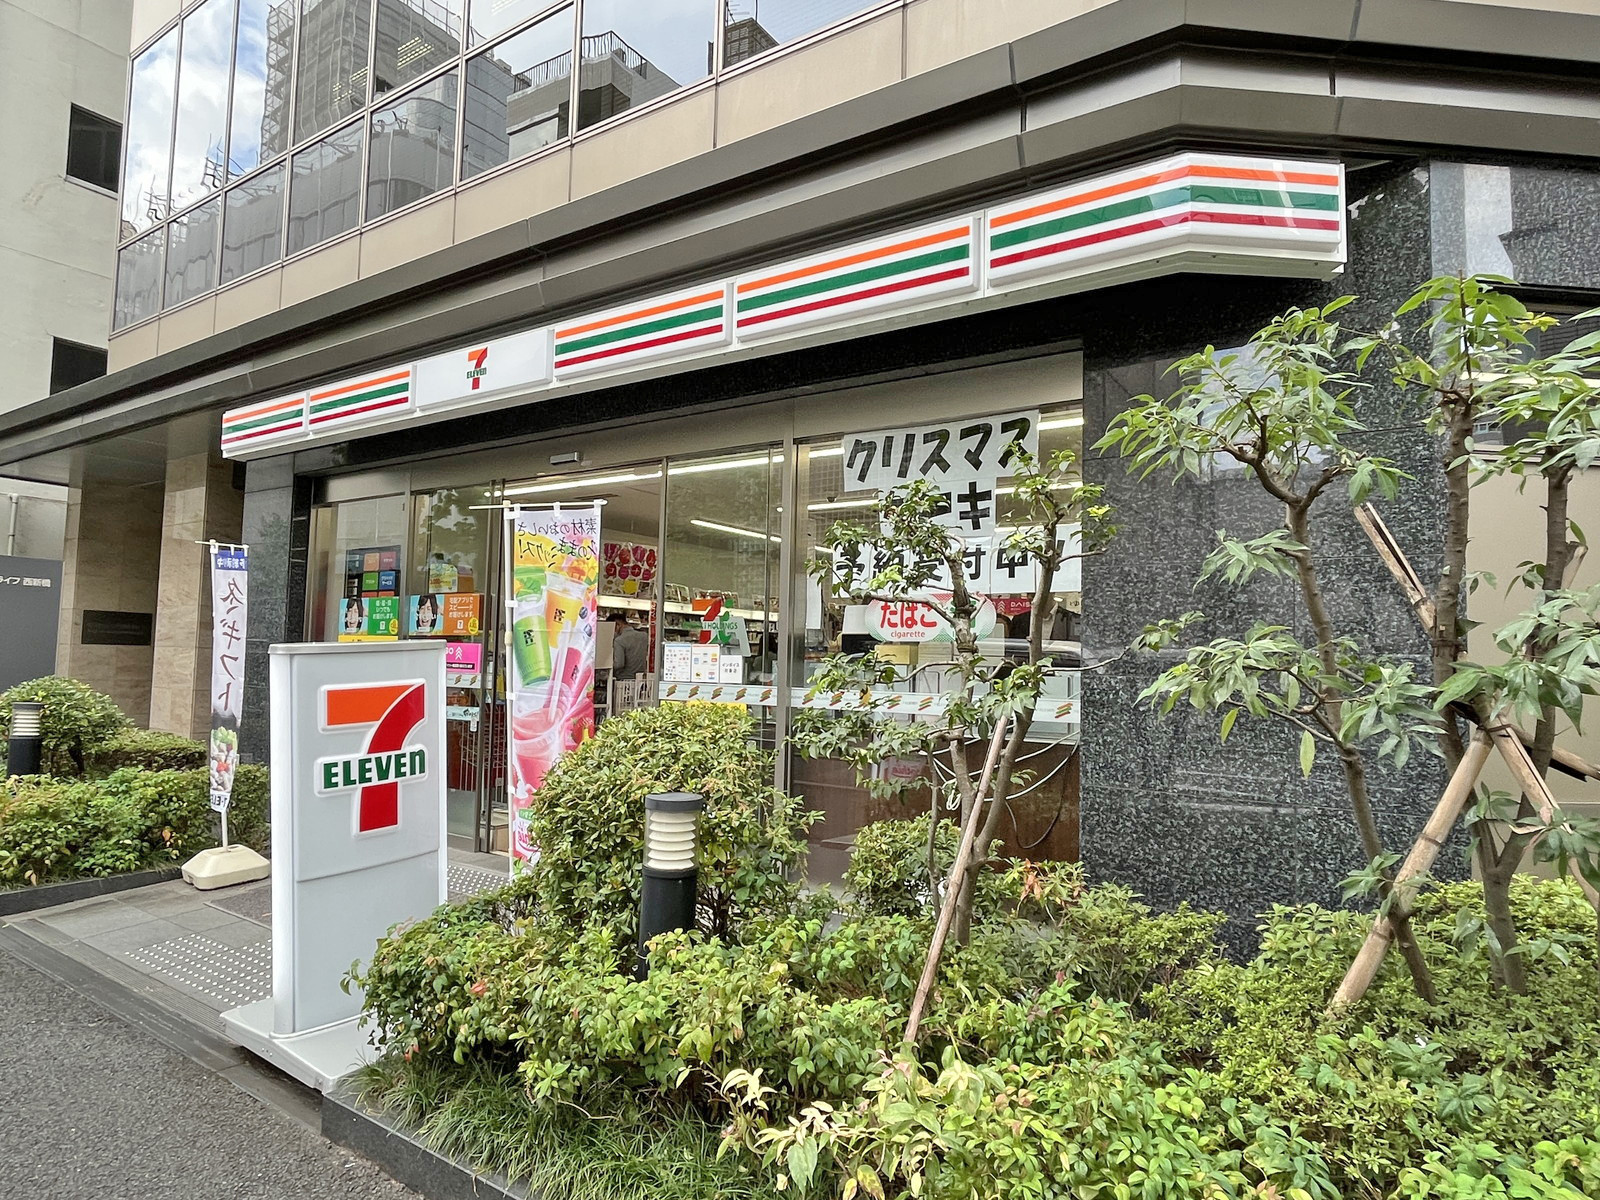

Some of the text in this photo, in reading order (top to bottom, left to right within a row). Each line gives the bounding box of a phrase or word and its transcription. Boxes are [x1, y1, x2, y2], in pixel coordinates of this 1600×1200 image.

[846, 417, 1034, 483] クリスマス
[880, 599, 938, 629] たばこ
[890, 629, 926, 639] cigarette
